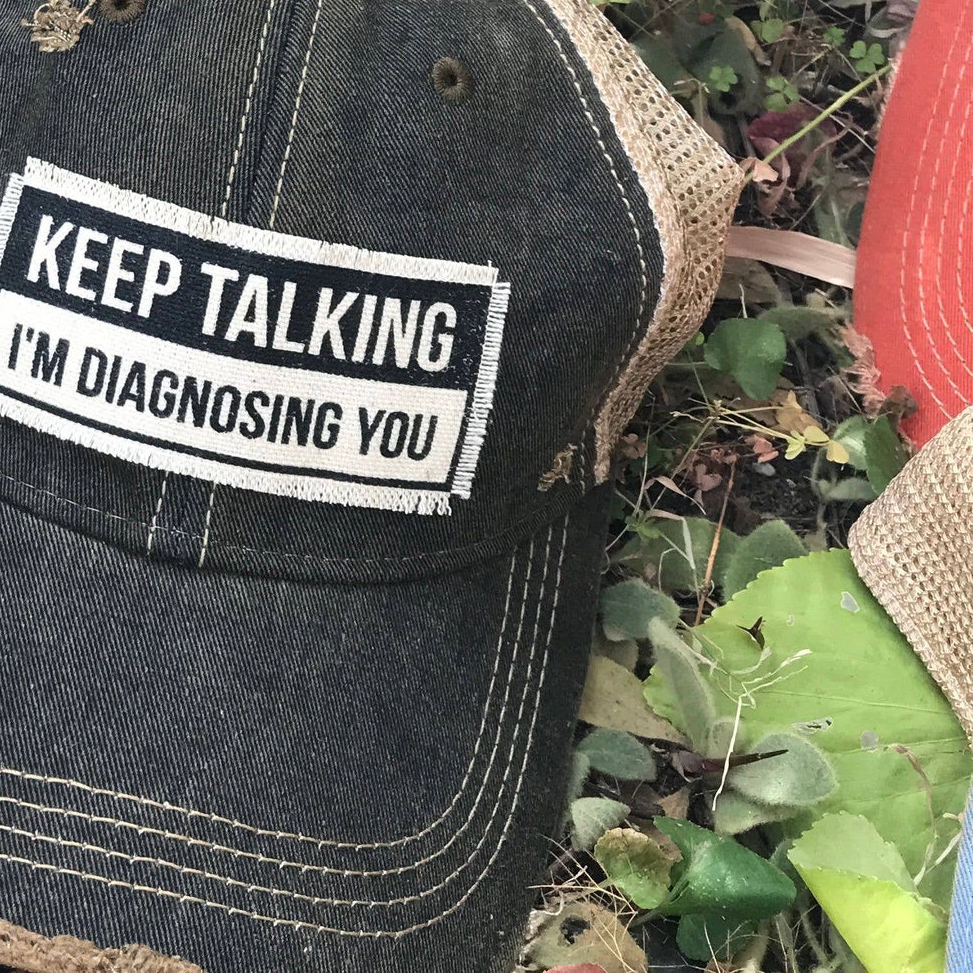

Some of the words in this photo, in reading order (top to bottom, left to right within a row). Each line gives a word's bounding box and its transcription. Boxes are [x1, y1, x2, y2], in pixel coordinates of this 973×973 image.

[26, 215, 181, 318] KEEP
[200, 264, 455, 372] TALKING
[7, 323, 69, 387] I'M
[77, 346, 342, 449] DIAGNOSING
[358, 407, 437, 461] YOU
